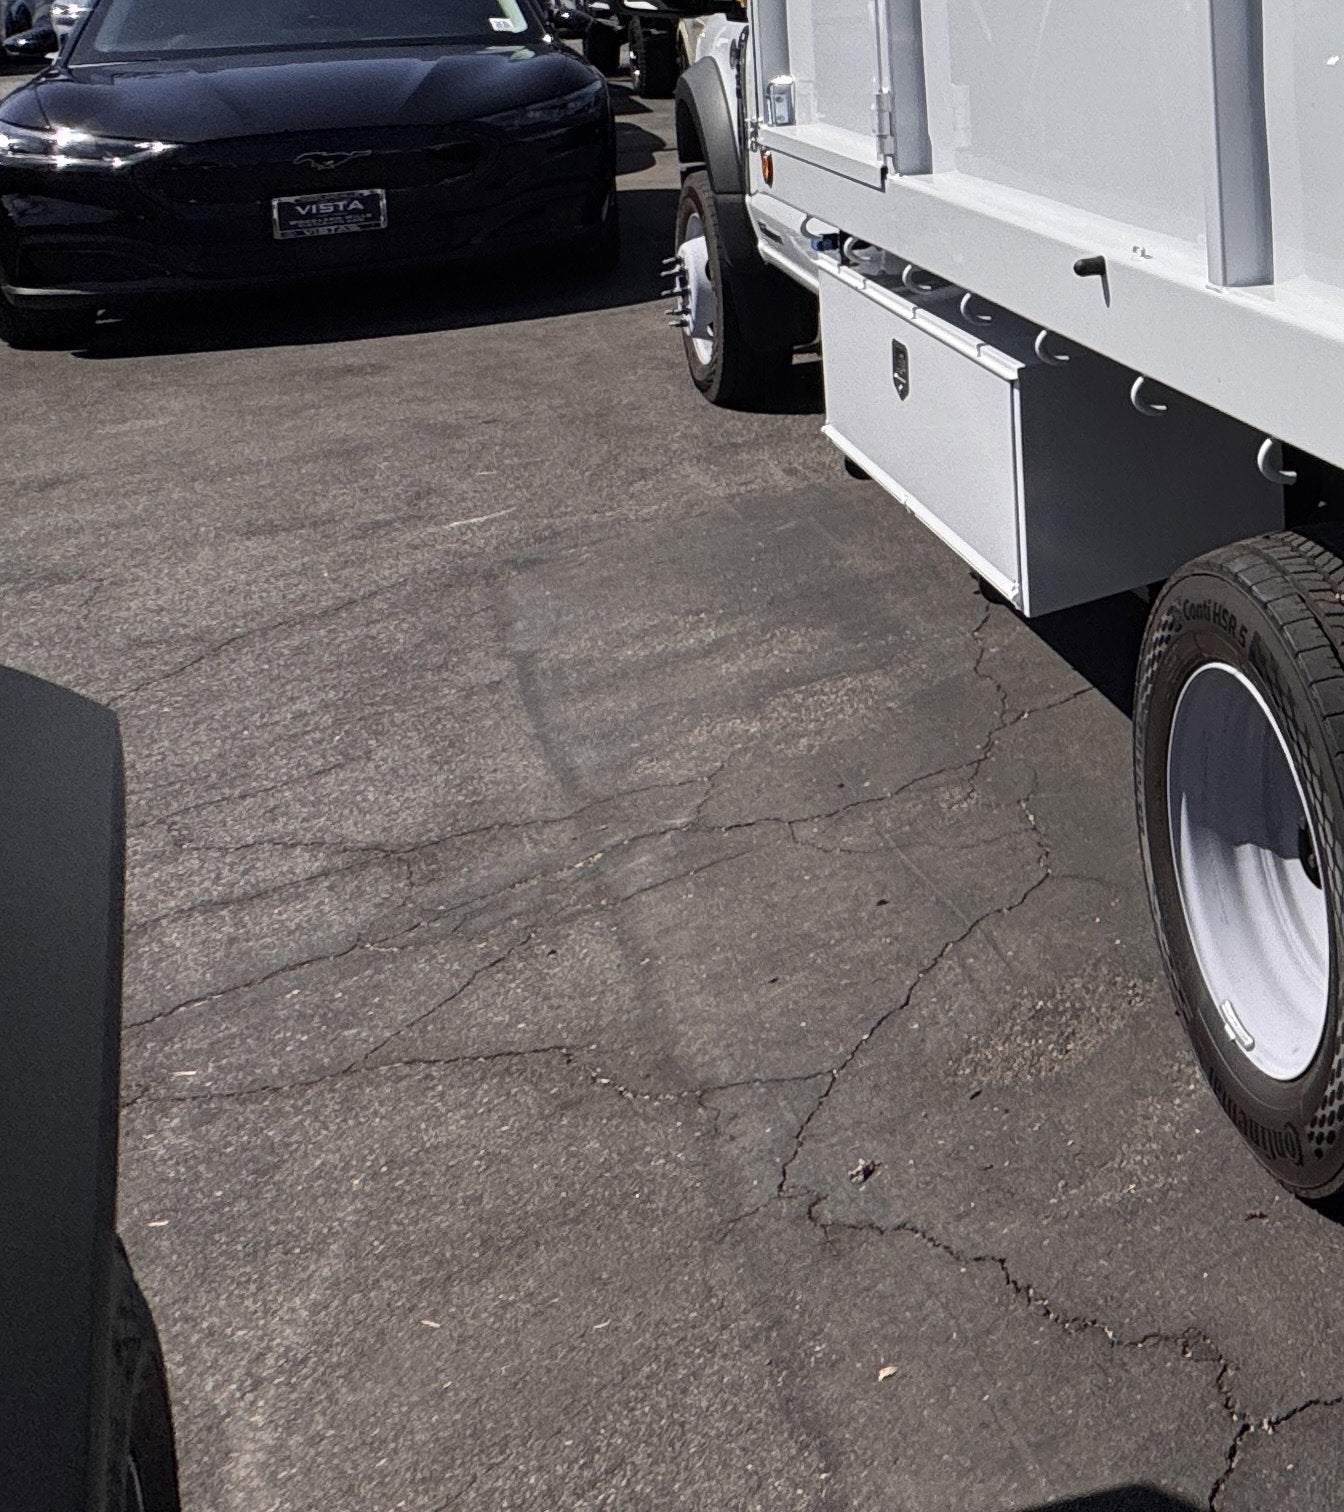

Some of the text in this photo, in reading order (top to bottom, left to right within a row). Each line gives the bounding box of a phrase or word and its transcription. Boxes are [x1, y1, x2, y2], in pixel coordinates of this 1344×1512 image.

[295, 200, 364, 215] VISTA
[1183, 599, 1211, 622] Conti
[1213, 602, 1237, 638] HSR
